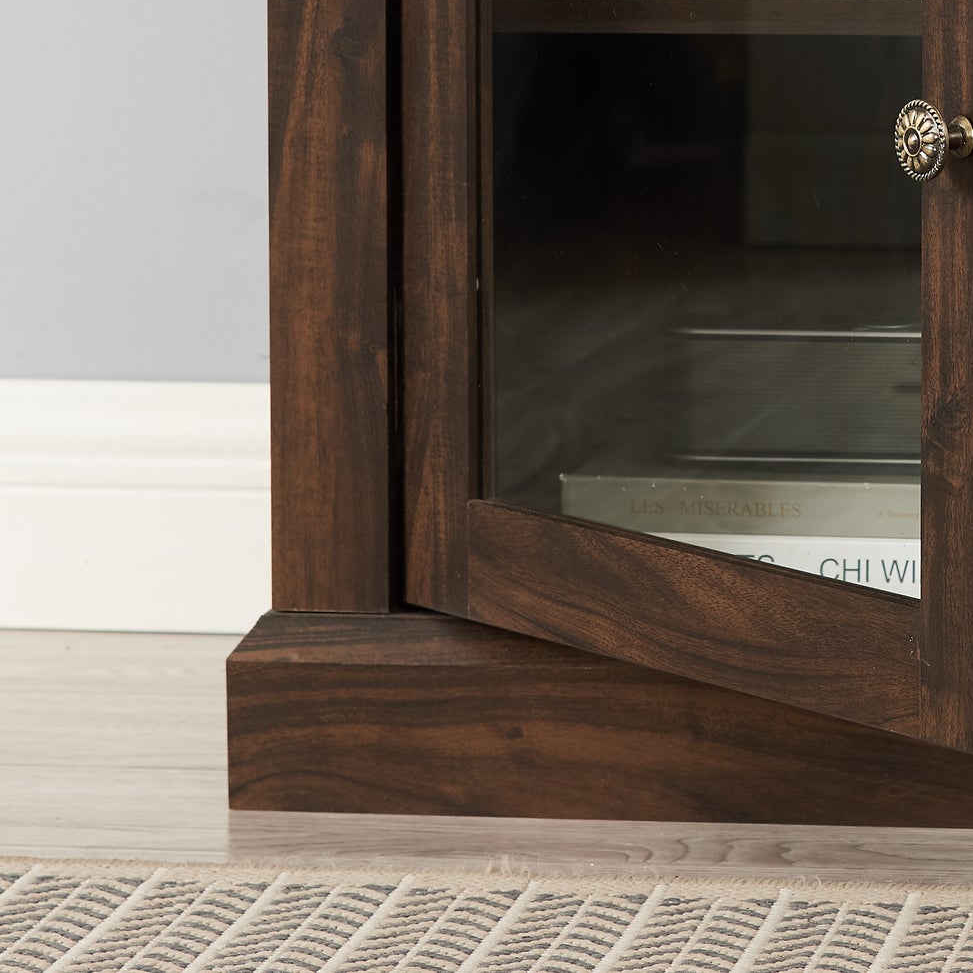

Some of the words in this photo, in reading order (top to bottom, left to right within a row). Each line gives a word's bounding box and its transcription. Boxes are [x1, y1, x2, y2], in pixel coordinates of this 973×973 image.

[630, 498, 665, 515] LES
[680, 499, 802, 519] MISERABLES
[819, 557, 870, 583] CHI
